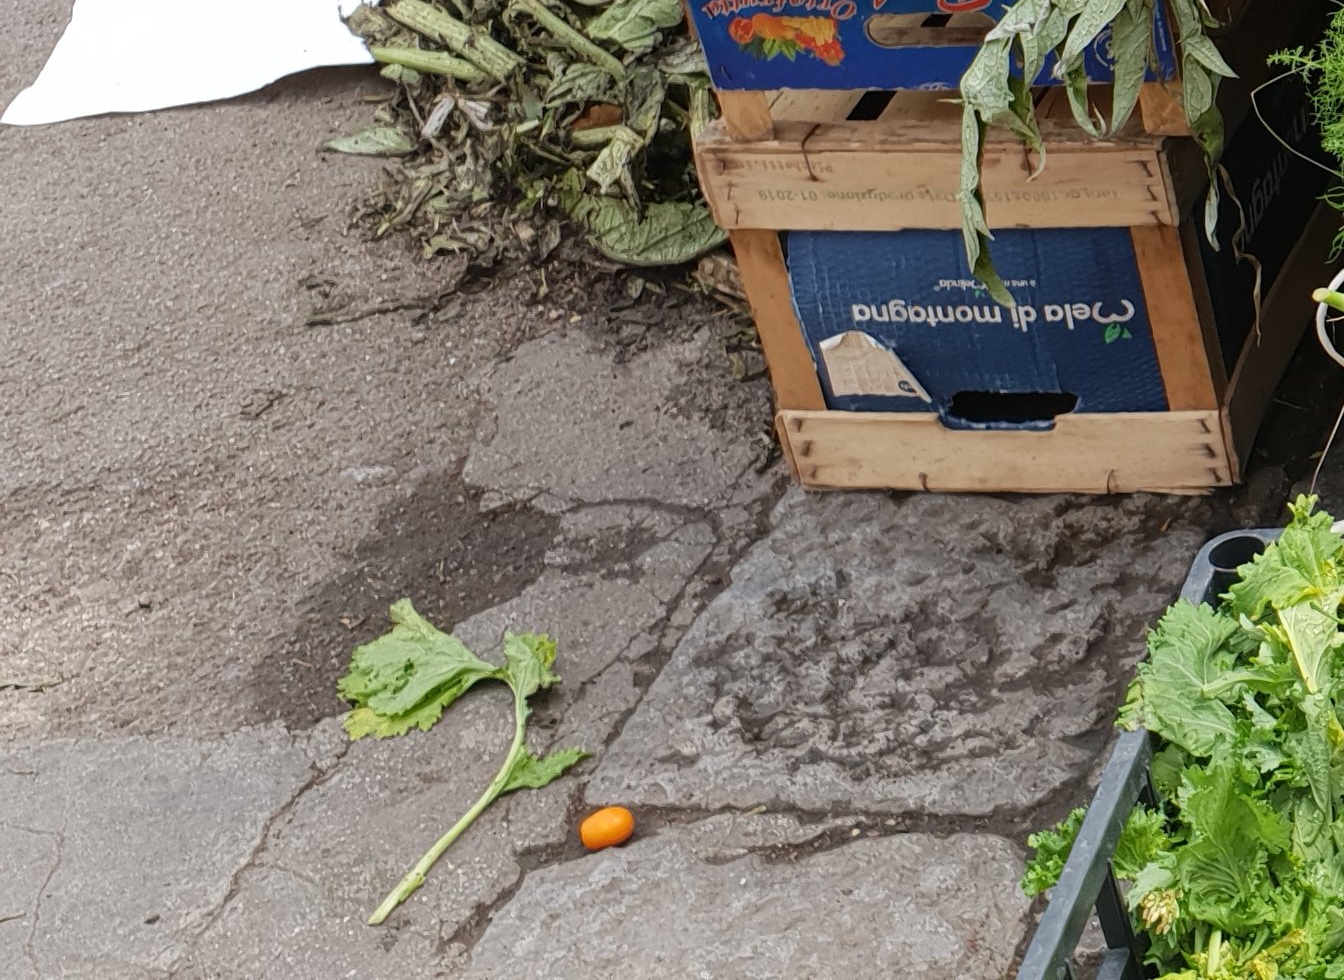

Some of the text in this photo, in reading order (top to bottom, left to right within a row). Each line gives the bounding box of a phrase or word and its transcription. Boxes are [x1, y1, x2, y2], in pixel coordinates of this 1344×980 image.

[757, 189, 818, 203] 01-2019
[852, 299, 1135, 332] Mela di montagna
